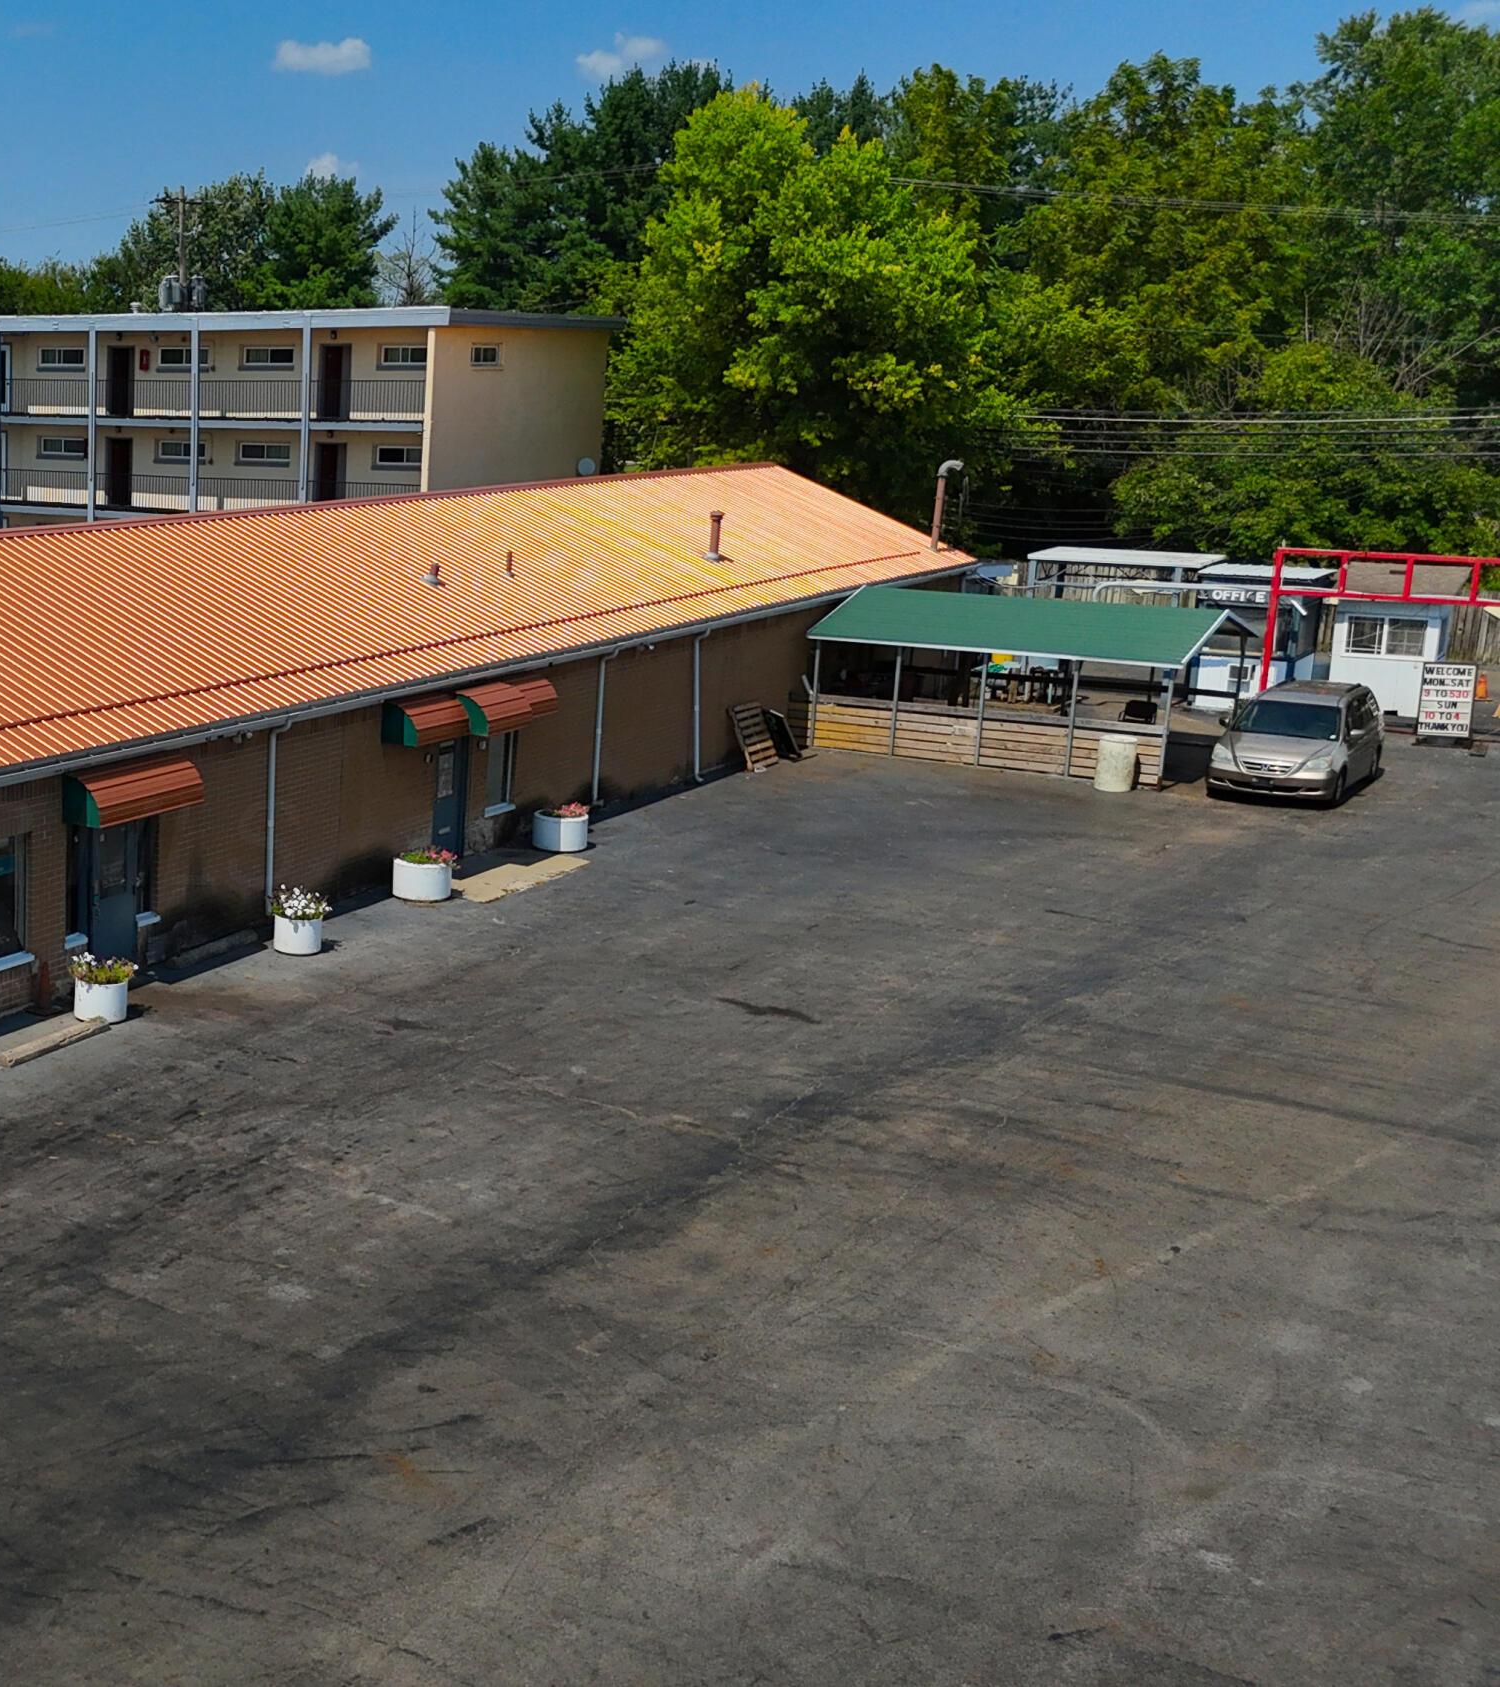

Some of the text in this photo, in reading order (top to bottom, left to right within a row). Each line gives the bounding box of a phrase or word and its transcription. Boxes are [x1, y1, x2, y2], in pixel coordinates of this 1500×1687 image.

[1425, 667, 1473, 676] WELCOME
[1424, 688, 1469, 698] 9 TO 530
[1437, 701, 1458, 709] SUN
[1425, 711, 1460, 720] 10 TO 4
[1419, 722, 1469, 732] THANK YOU
